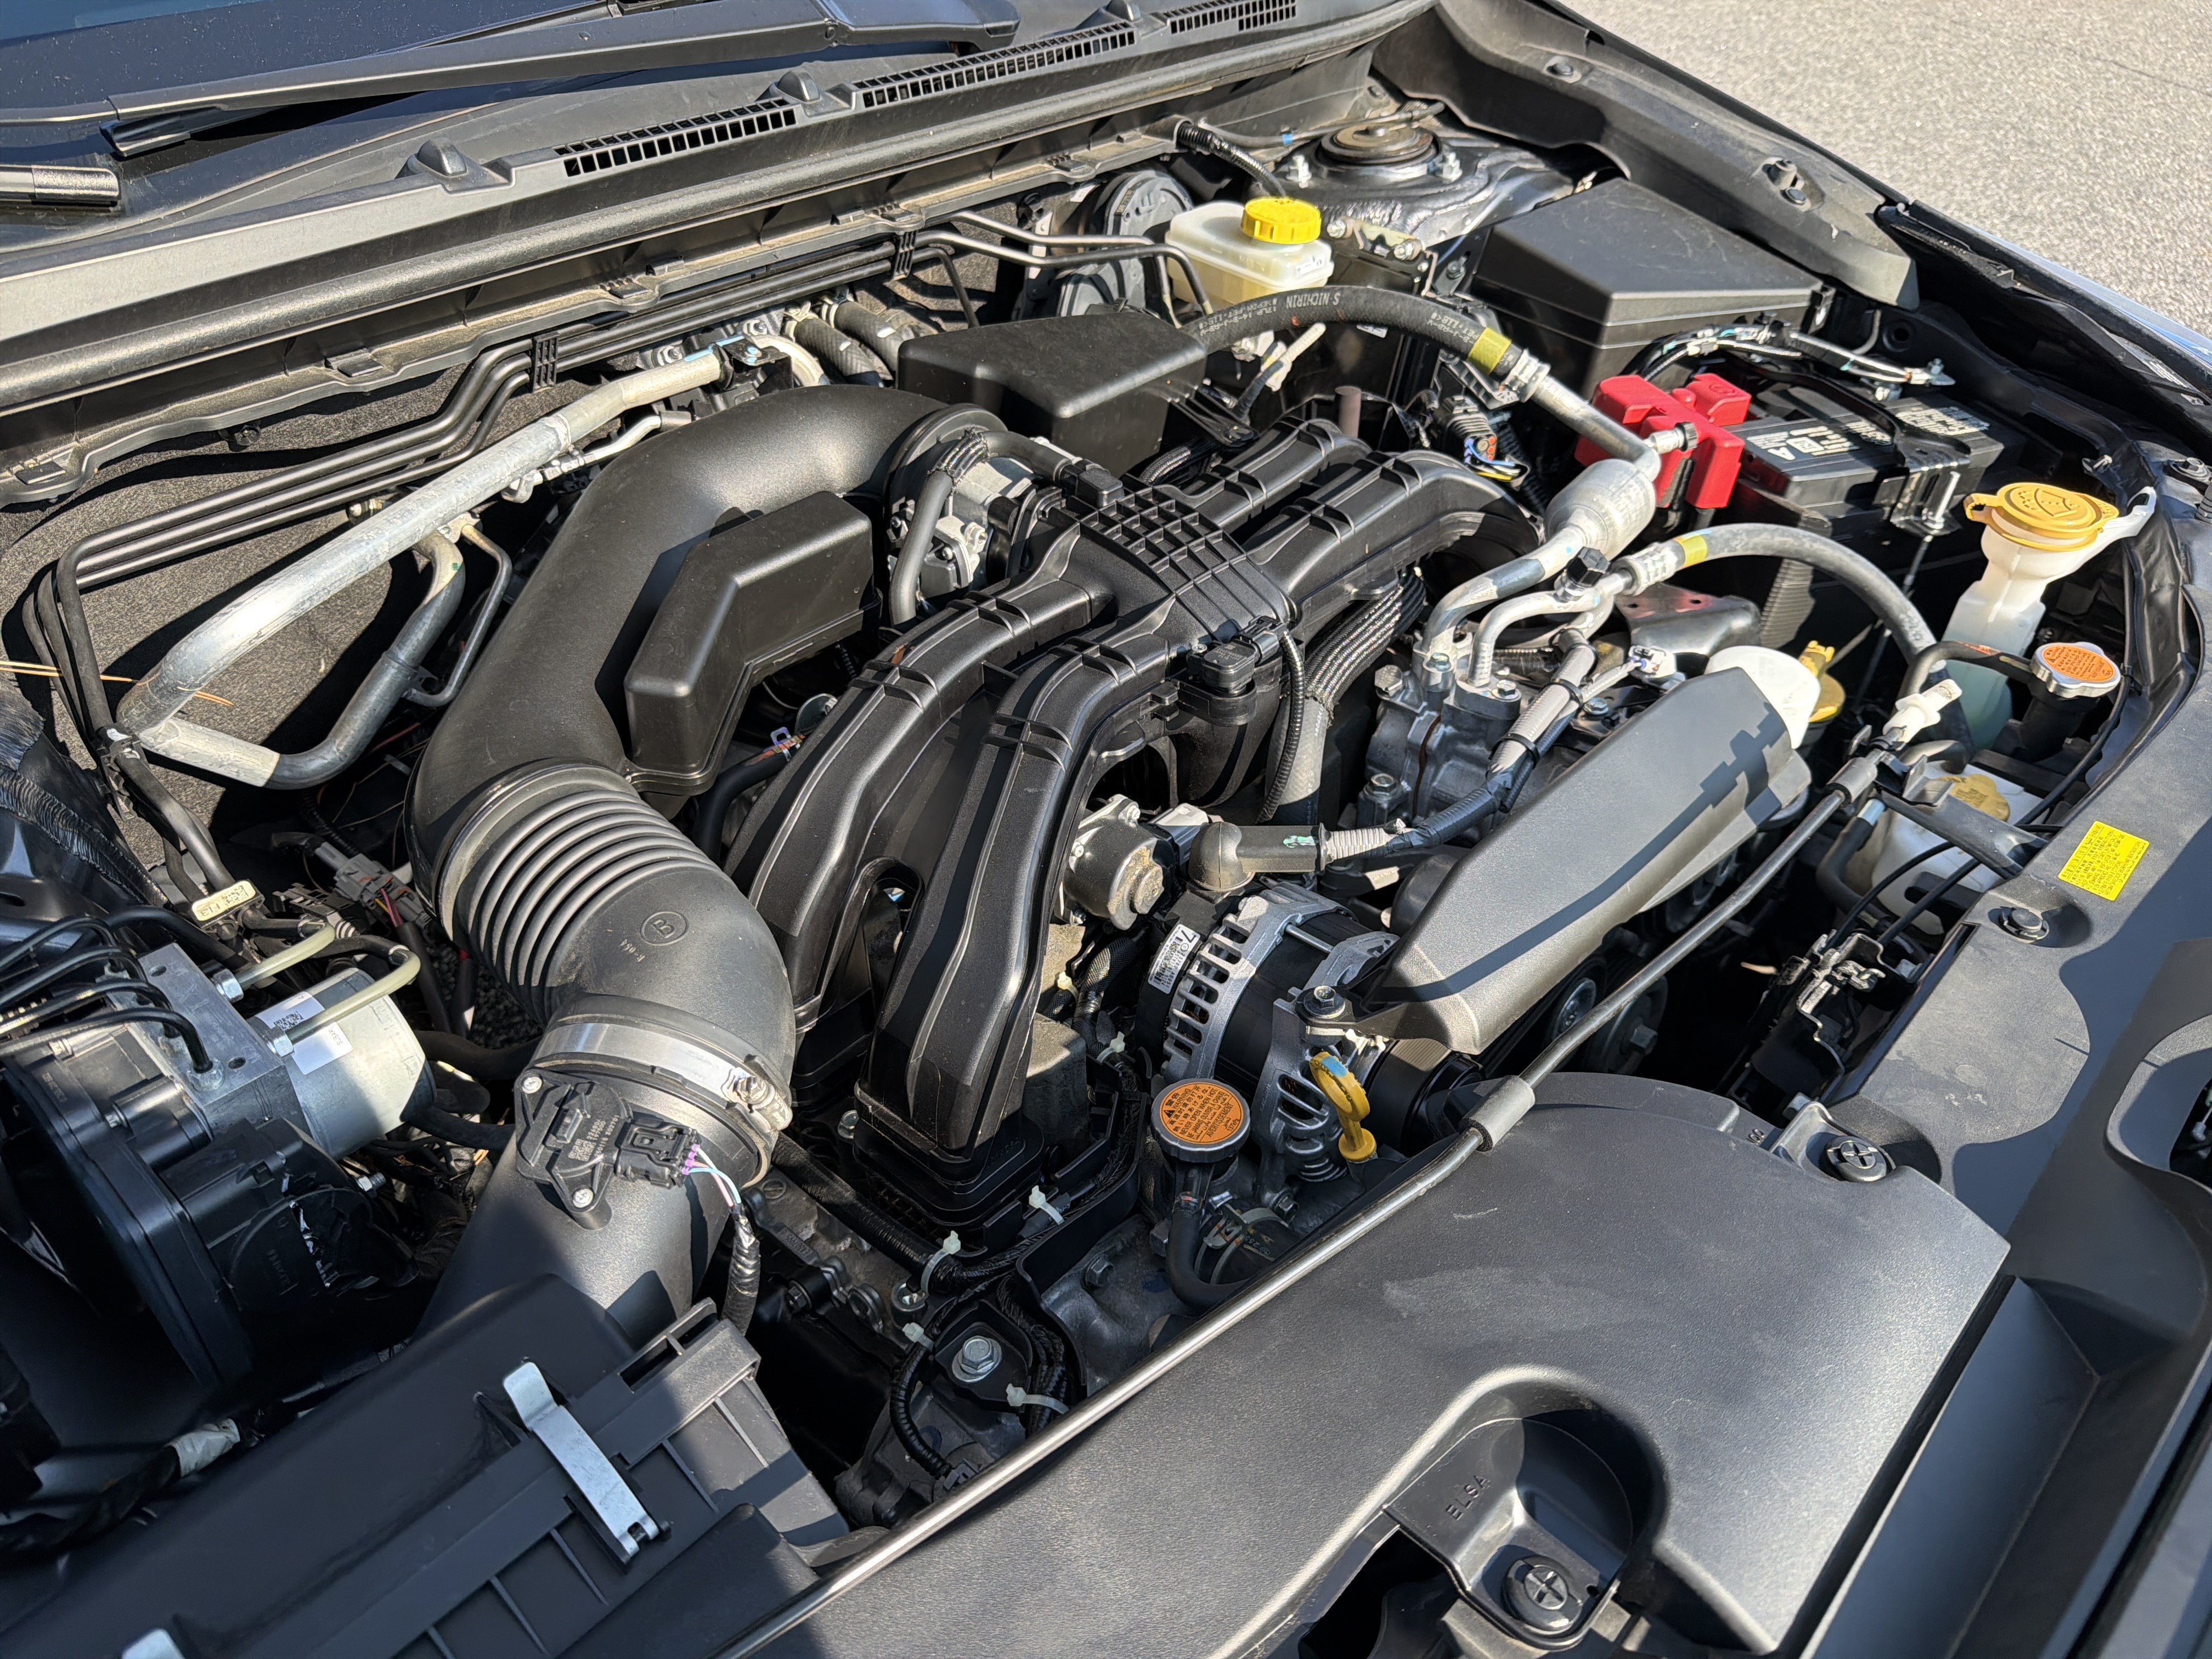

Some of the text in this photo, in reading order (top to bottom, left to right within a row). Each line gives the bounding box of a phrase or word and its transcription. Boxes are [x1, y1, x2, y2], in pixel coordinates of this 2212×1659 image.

[1181, 930, 1197, 943] 7
[1172, 1088, 1190, 1109] WARNING
[1180, 1121, 1193, 1136] NEVER
[1189, 1109, 1202, 1121] OPEN
[1198, 1097, 1211, 1109] WHEN
[1206, 1102, 1233, 1138] AVERTISSEMENT
[1445, 1474, 1491, 1523] ELSA
